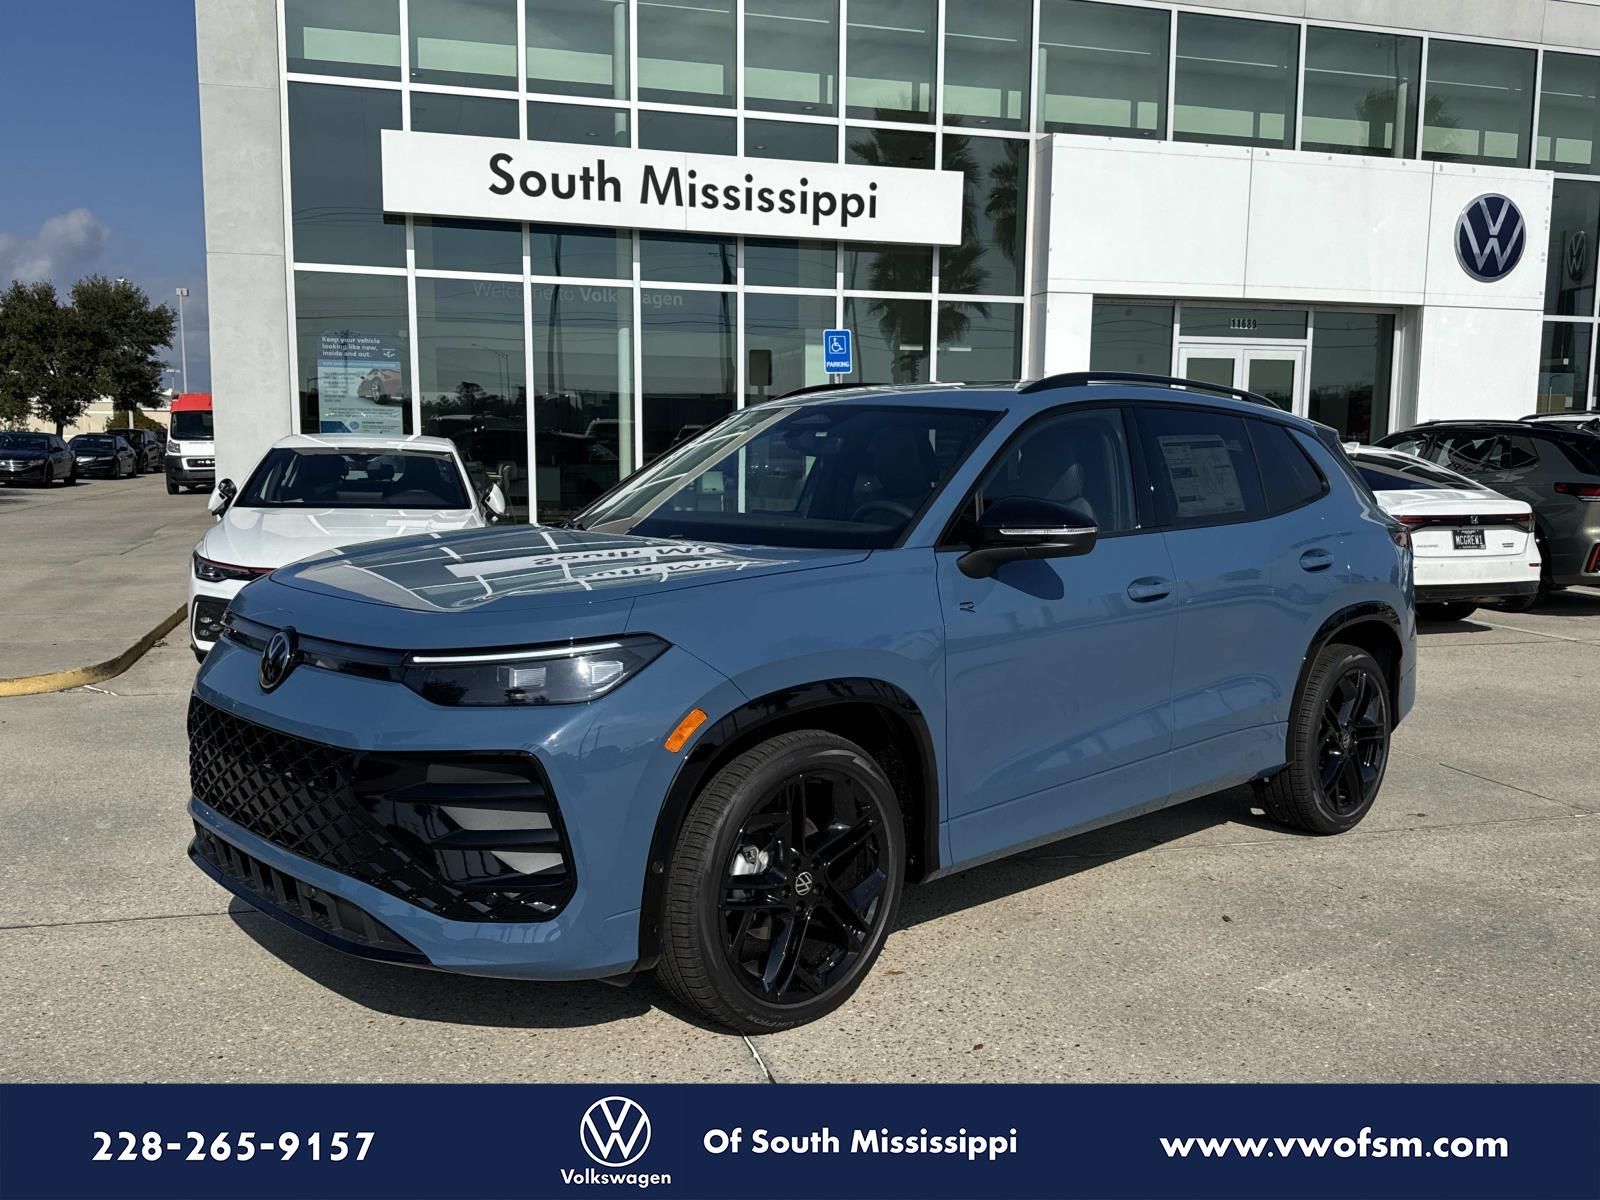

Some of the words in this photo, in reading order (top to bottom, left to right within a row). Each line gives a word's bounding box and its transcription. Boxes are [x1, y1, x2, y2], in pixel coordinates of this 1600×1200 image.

[488, 153, 621, 203] South
[640, 165, 878, 227] Mississippi
[579, 287, 684, 309] Volkagen
[1231, 318, 1257, 329] 11689
[321, 336, 339, 344] Keep
[321, 343, 347, 351] looking
[1455, 534, 1483, 546] MCGREW1
